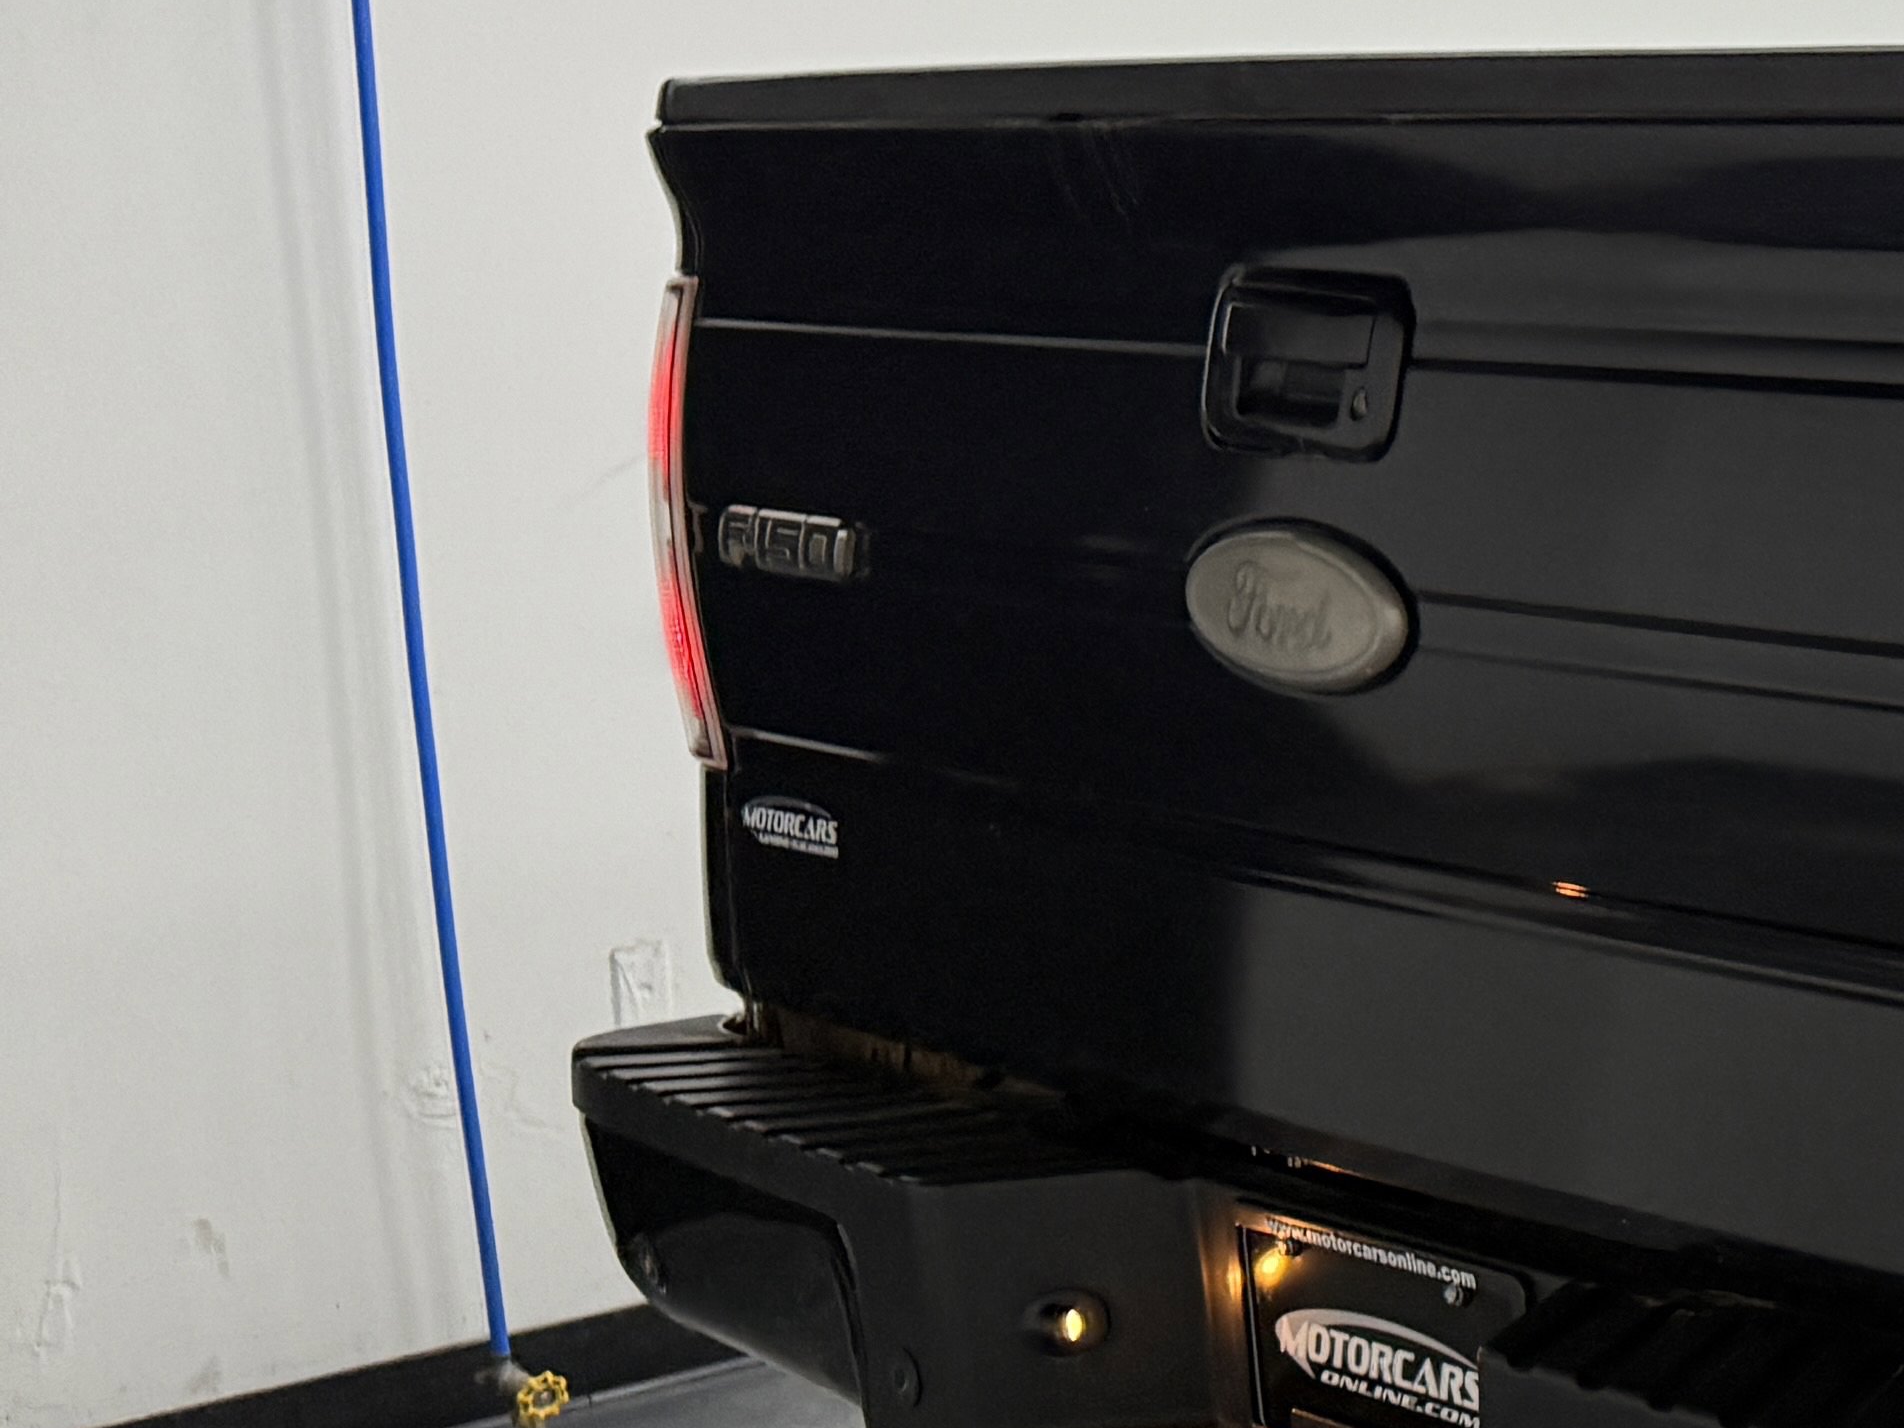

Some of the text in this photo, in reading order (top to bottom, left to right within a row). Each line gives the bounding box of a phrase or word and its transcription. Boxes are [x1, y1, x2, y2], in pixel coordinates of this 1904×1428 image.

[1227, 559, 1333, 650] Ford
[741, 804, 838, 844] MOTORCARS
[1266, 1218, 1477, 1289] www.motorcarsonline.com
[1280, 1322, 1480, 1410] MOTORCARS
